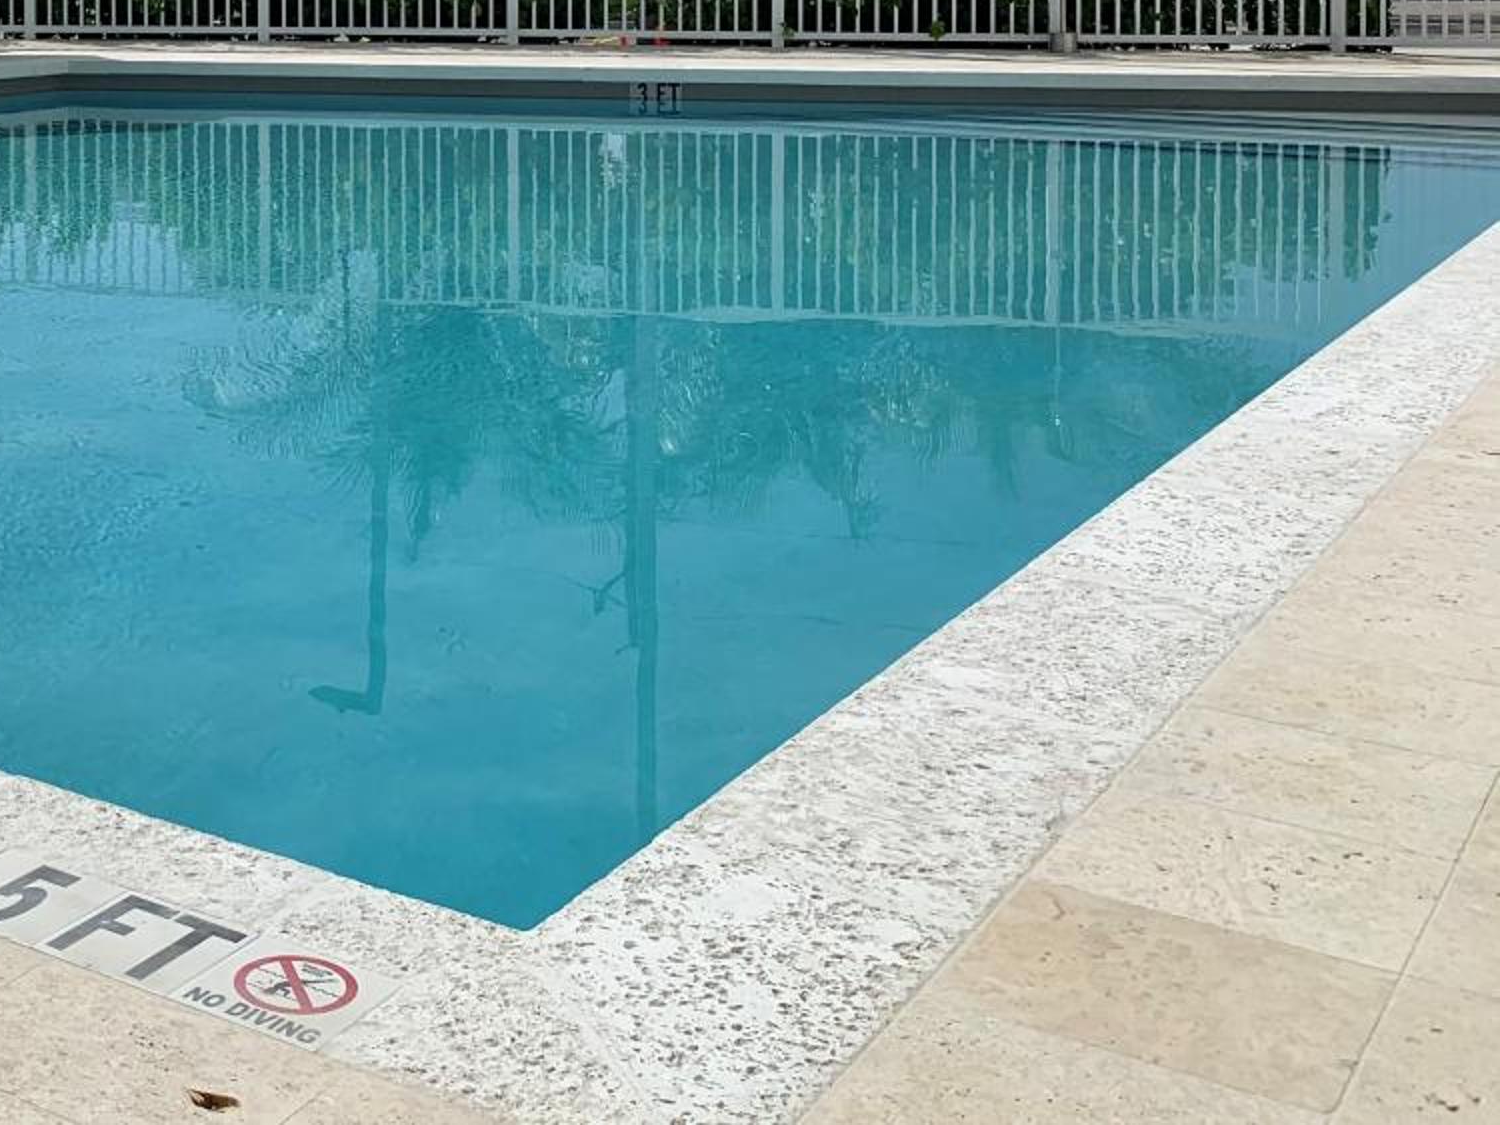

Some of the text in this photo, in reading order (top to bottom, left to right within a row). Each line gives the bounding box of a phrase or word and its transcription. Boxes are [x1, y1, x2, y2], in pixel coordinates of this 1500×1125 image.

[637, 82, 681, 101] 3 FT
[46, 894, 247, 981] FT
[183, 986, 322, 1044] NO DIVING
